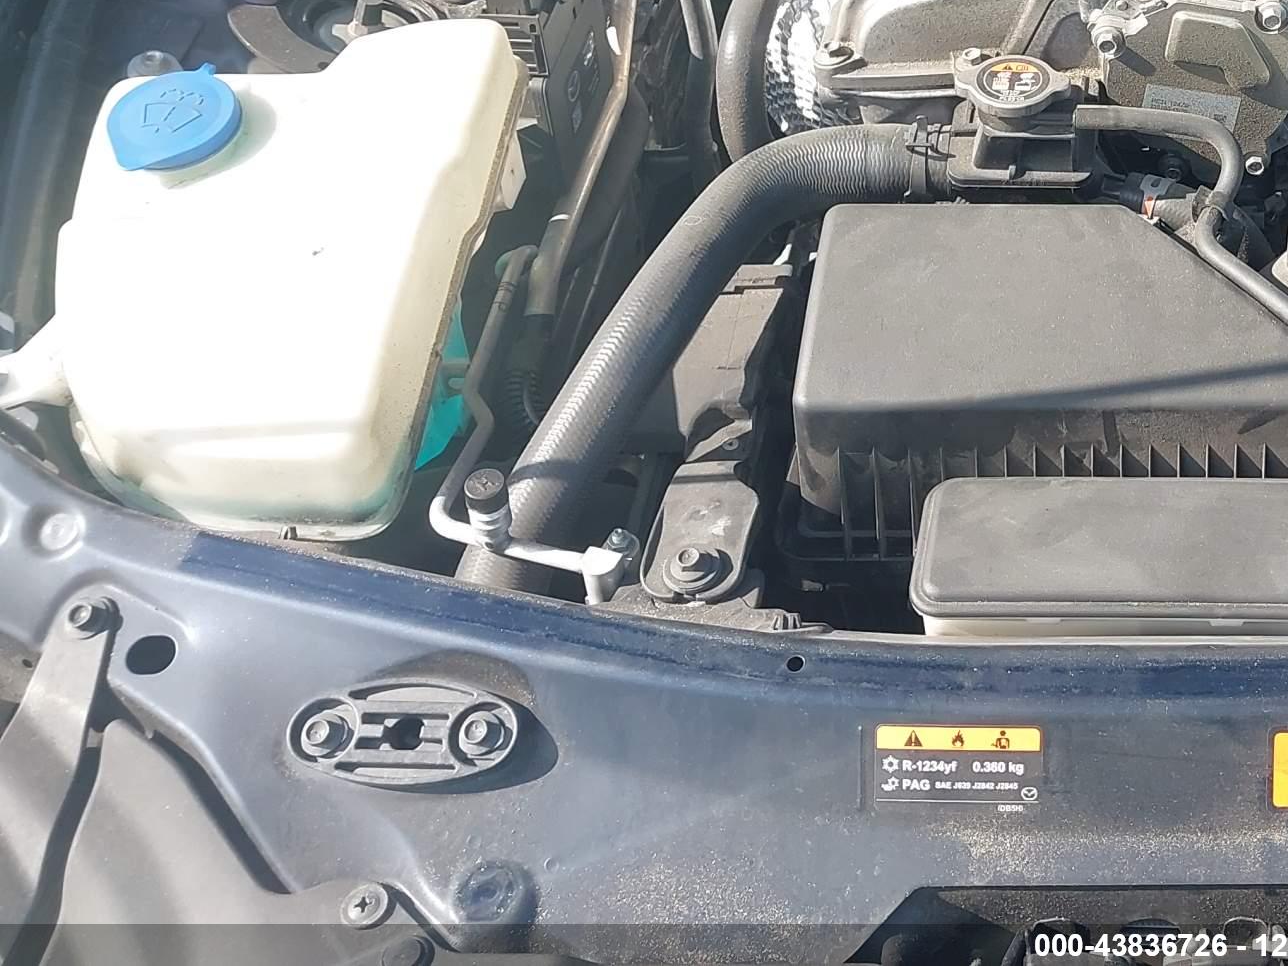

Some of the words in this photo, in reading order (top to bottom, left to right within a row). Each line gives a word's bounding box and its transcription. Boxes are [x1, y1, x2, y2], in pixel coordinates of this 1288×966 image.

[902, 760, 957, 775] R-1234yf
[1008, 762, 1024, 775] kg
[902, 778, 930, 790] PAG
